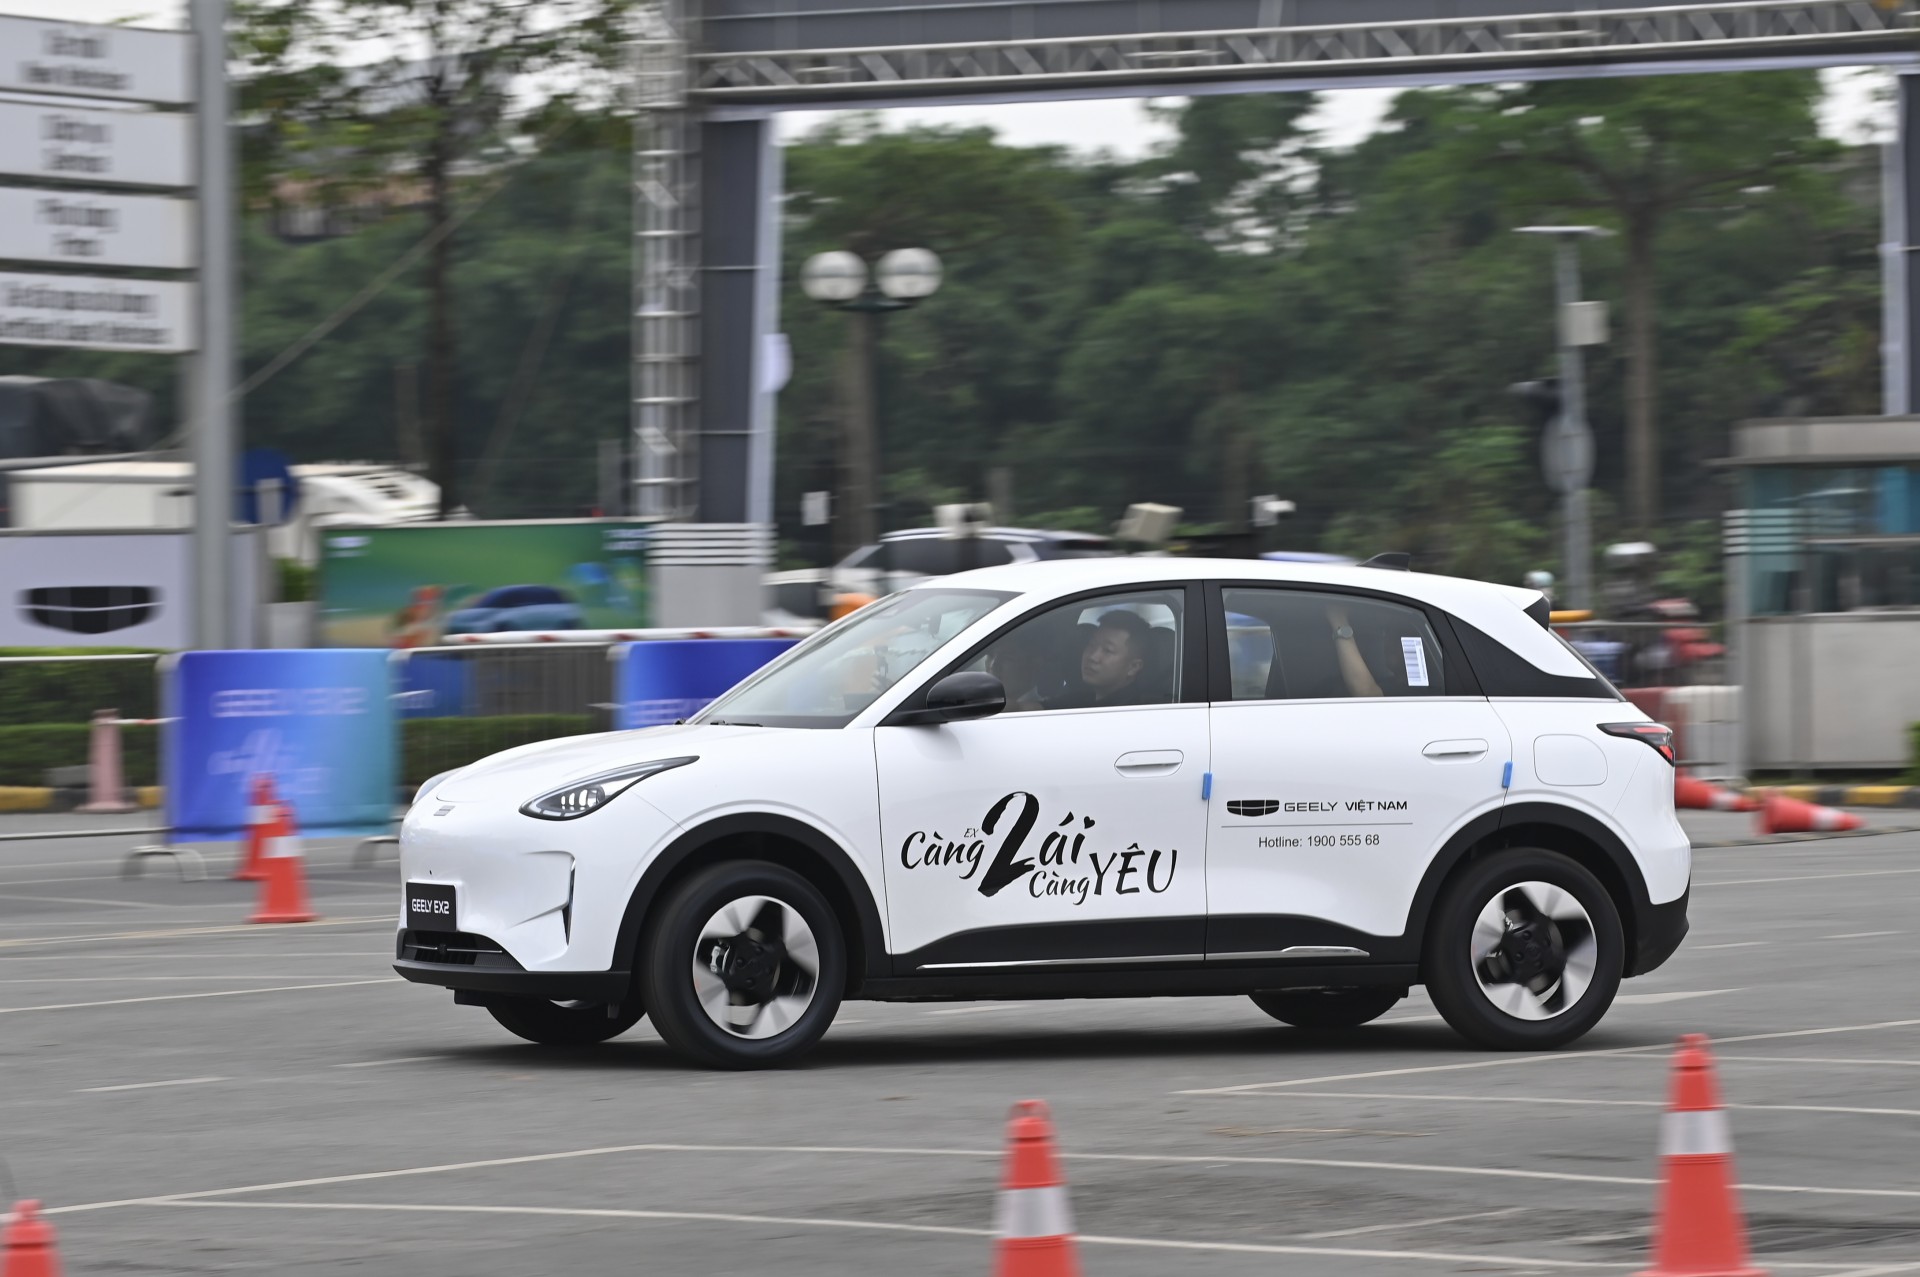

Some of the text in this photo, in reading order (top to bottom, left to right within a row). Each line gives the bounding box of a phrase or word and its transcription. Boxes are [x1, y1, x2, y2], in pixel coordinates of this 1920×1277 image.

[1283, 799, 1408, 813] GEELY VIỆT NAM
[1258, 834, 1380, 848] Hotline: 1900 555 68
[900, 830, 985, 880] Càng
[1029, 842, 1178, 906] Càng YÊU
[411, 898, 450, 915] GEELY EX2
